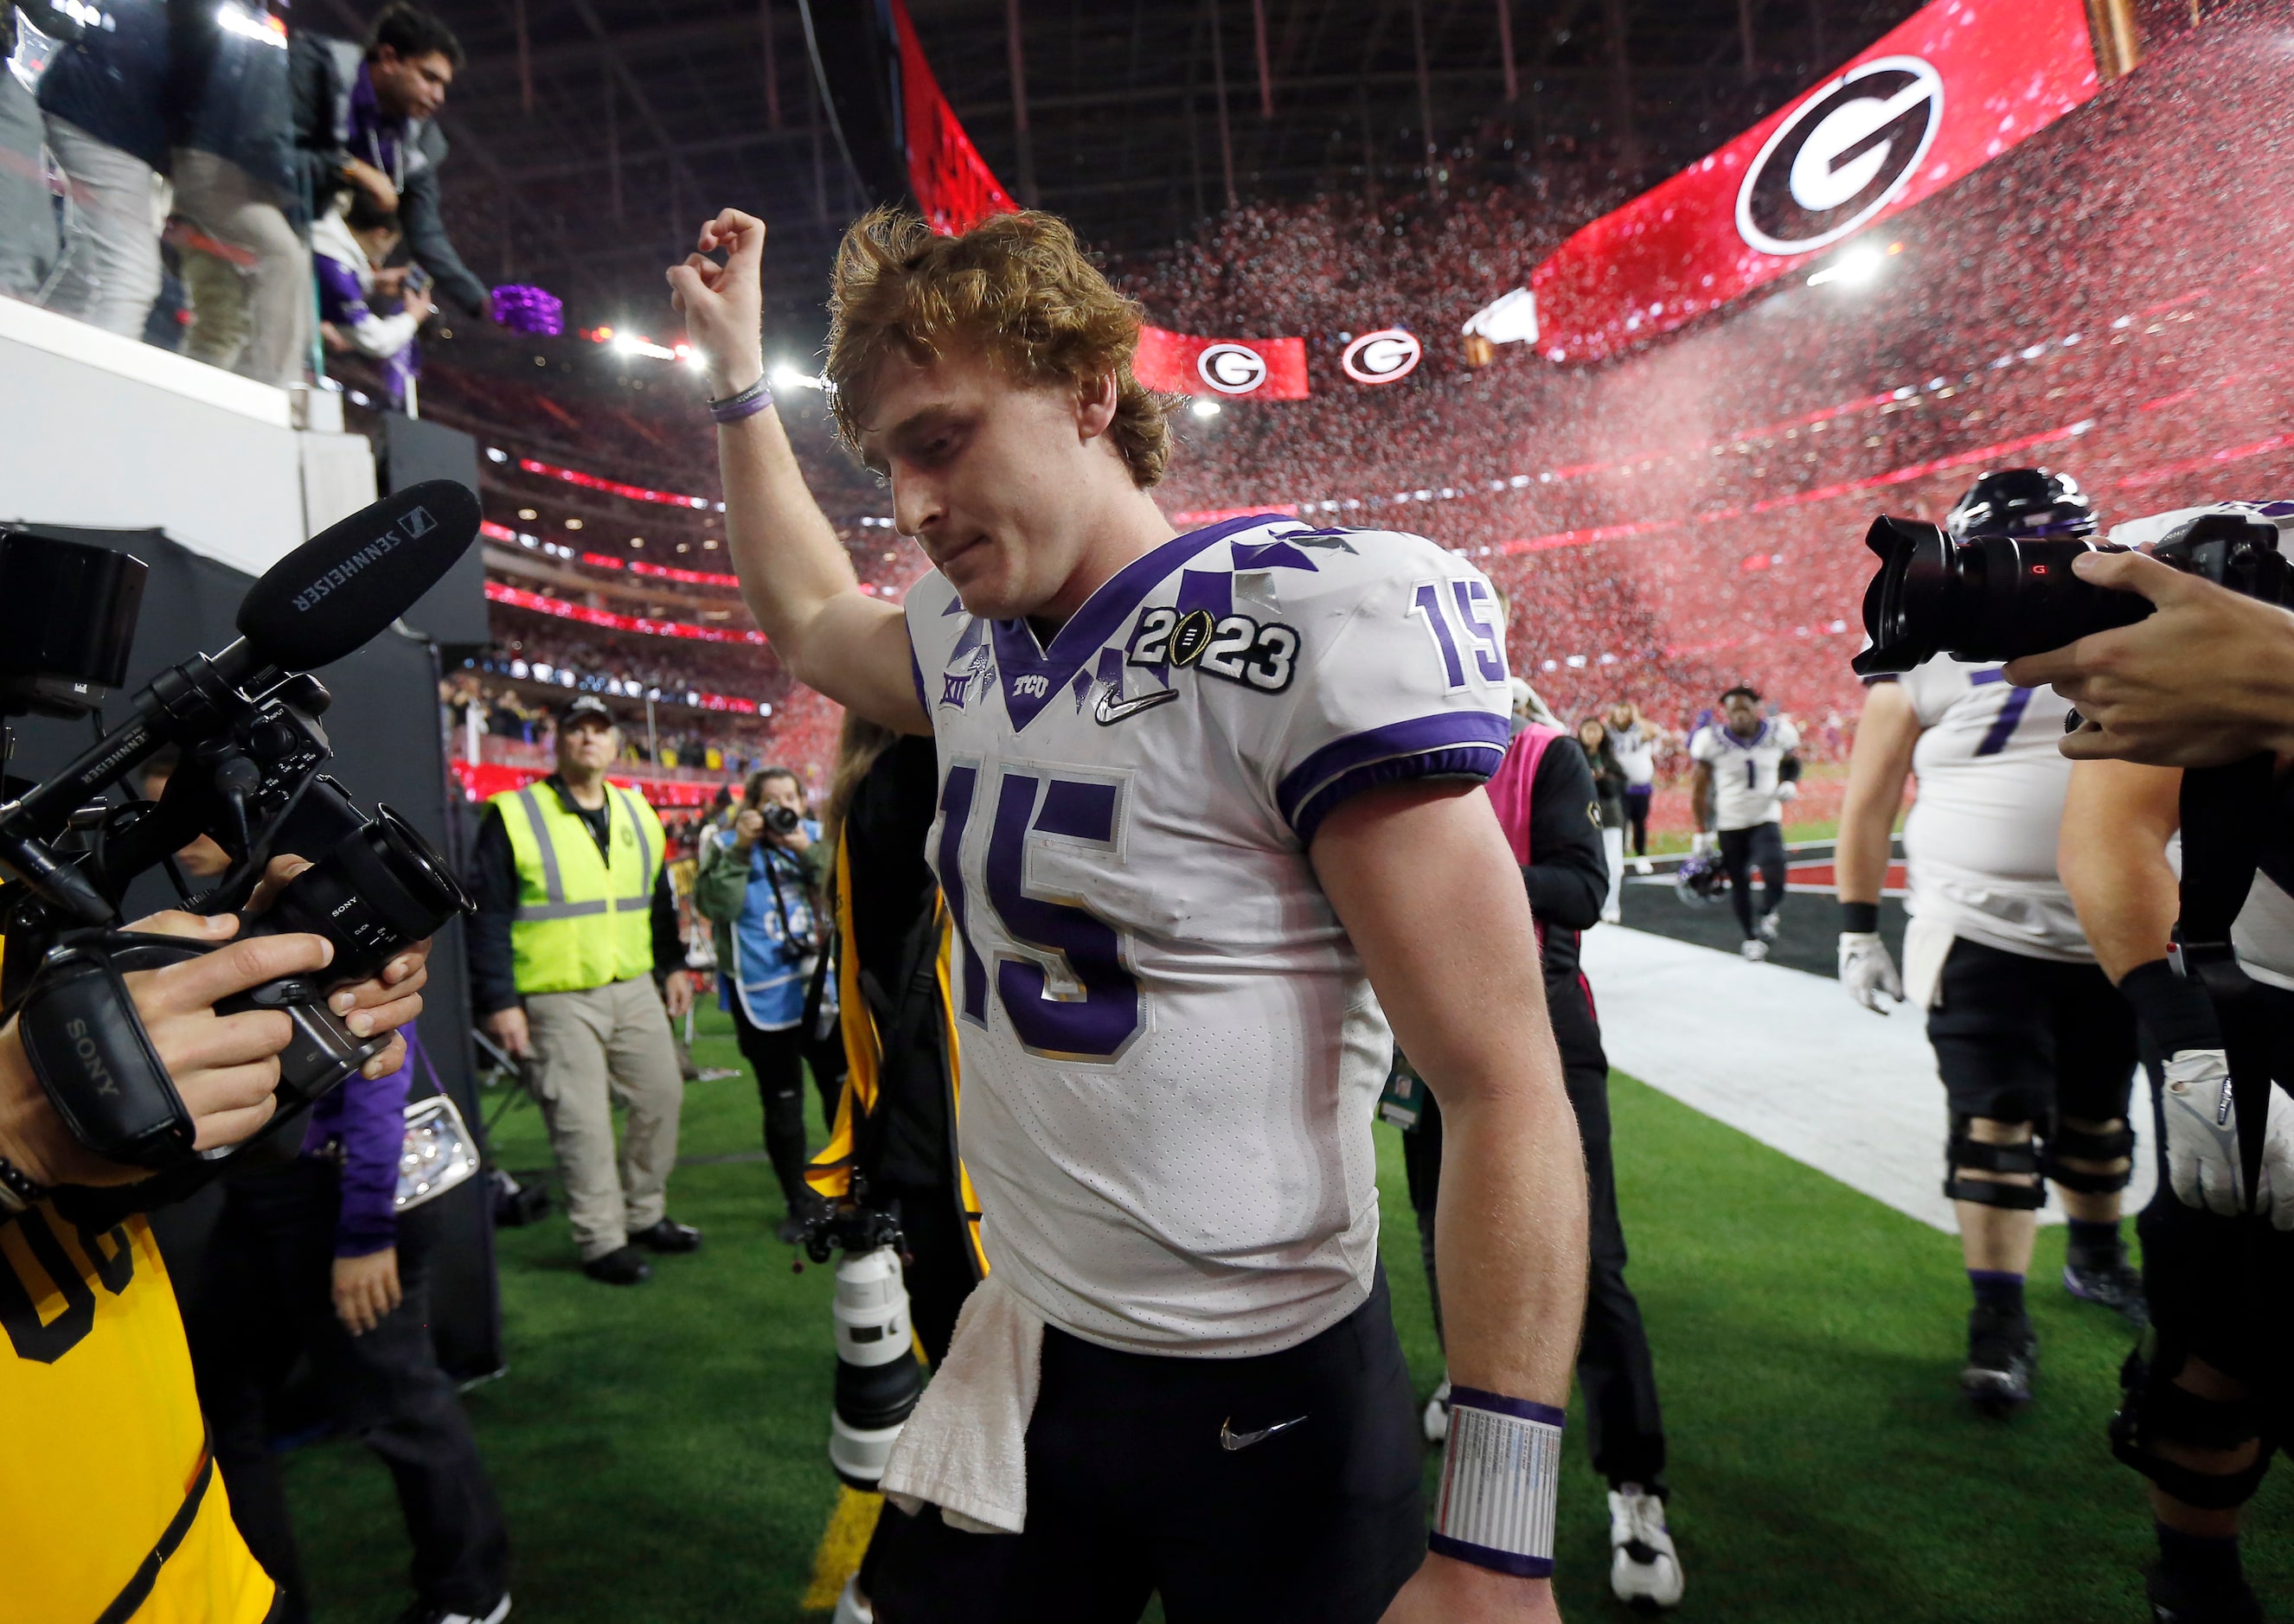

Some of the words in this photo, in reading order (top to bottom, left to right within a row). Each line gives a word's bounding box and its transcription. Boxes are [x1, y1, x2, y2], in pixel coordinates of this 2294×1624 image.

[1735, 54, 1945, 255] G
[1197, 343, 1266, 394] G
[1342, 329, 1421, 383] G
[292, 529, 402, 612] SENNHEISER
[1413, 580, 1506, 688] 15
[1012, 675, 1049, 700] TCU
[80, 730, 150, 783] SENNHEISER
[1745, 758, 1756, 790] 1
[331, 896, 357, 917] SONY
[938, 762, 1144, 1061] 15
[66, 1018, 119, 1097] SONY
